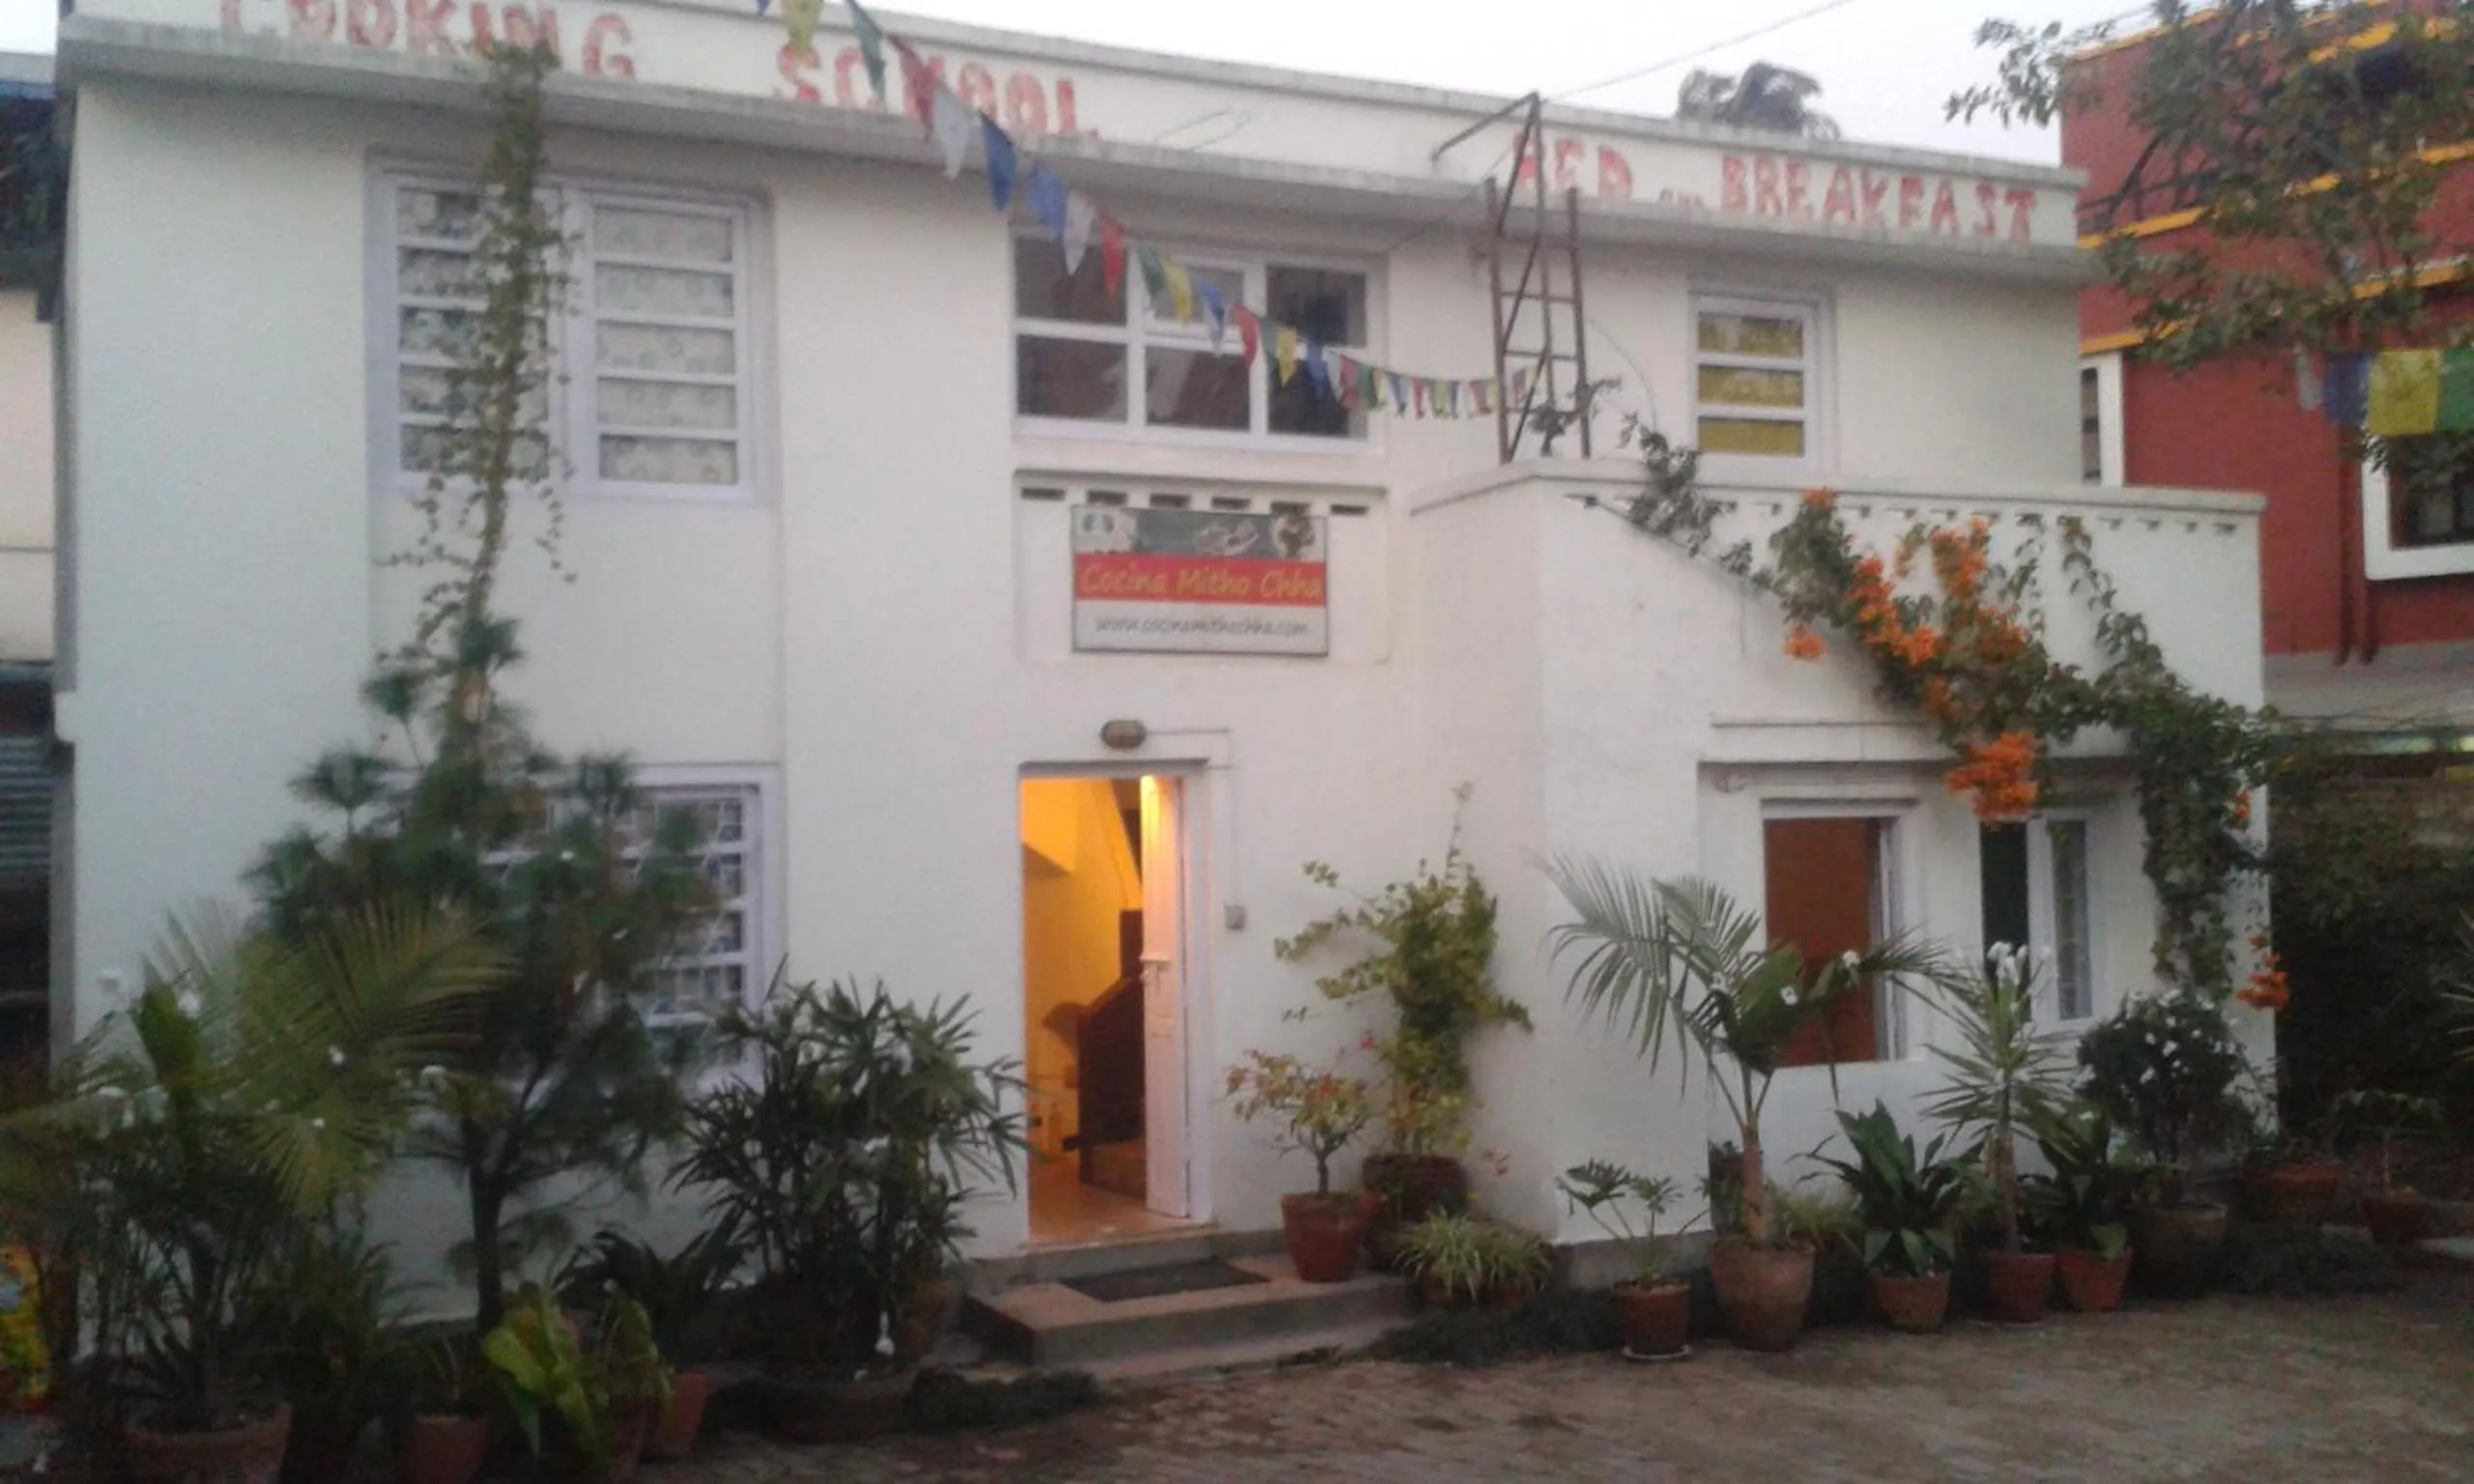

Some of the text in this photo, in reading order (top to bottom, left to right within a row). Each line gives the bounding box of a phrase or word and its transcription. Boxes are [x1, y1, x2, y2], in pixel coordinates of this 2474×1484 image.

[1721, 152, 2037, 242] BREAKFAST
[1080, 562, 1323, 599] Cocina Mitho Chha
